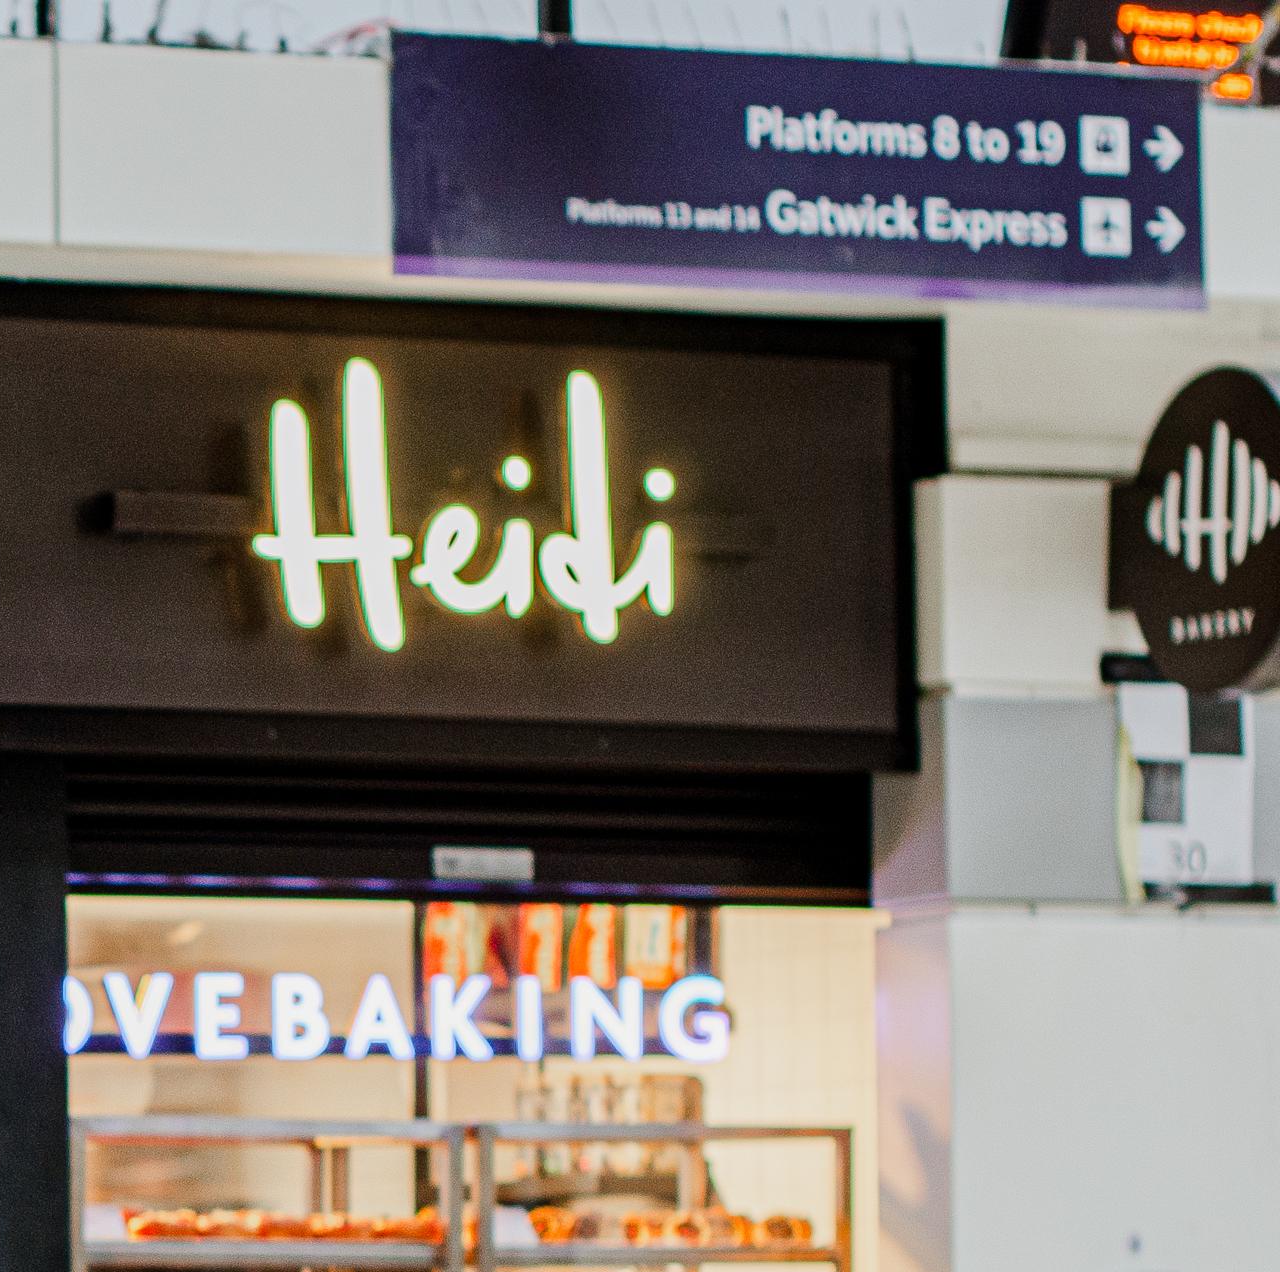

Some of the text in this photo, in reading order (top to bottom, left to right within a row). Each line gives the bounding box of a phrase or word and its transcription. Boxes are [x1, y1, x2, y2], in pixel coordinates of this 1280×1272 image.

[745, 104, 1066, 166] Platforms 8 to 19
[566, 197, 663, 229] Platforms
[694, 203, 732, 232] and
[765, 189, 919, 239] Gatwick
[923, 196, 1068, 252] Express
[252, 356, 676, 653] Heidi
